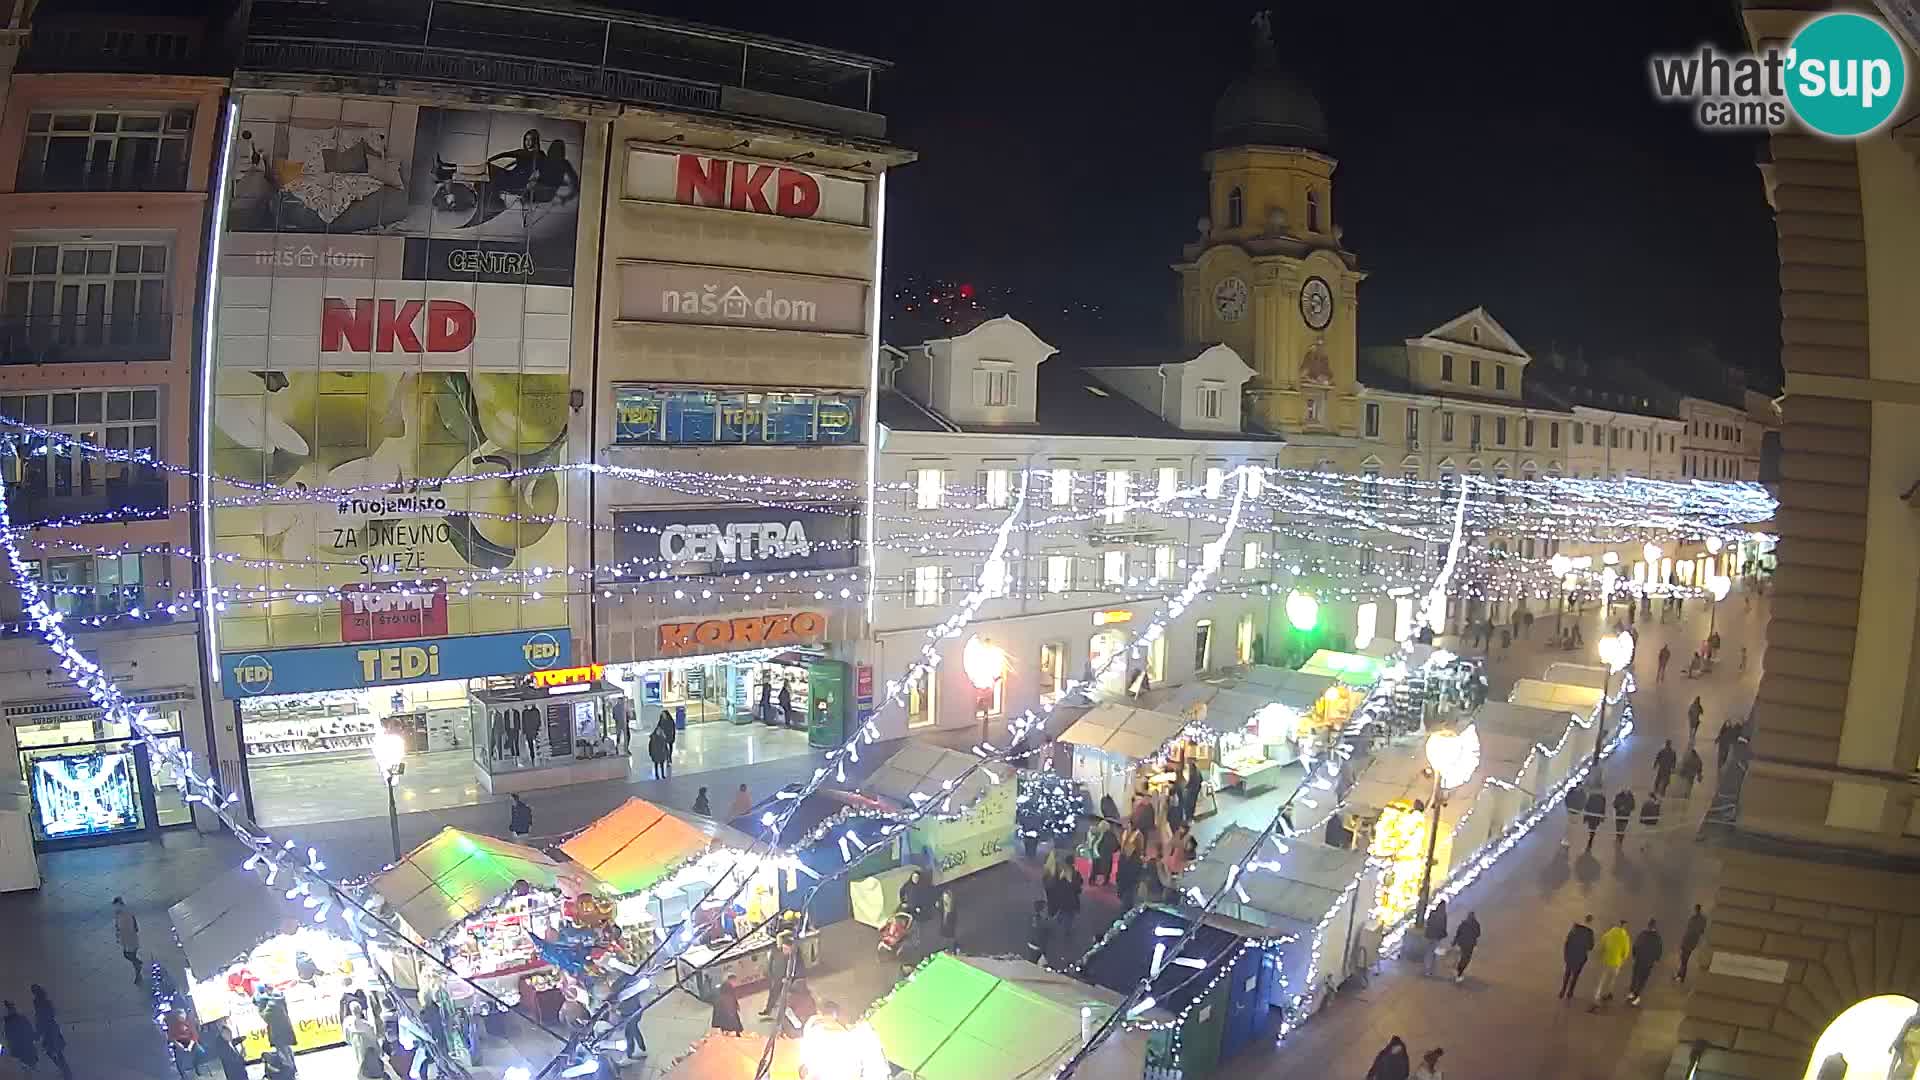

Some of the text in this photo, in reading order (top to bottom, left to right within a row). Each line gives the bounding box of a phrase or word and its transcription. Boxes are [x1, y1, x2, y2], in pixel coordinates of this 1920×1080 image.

[675, 153, 820, 218] NKD
[447, 249, 536, 276] CENTRA
[662, 284, 817, 323] naš dom
[320, 296, 477, 354] NKD
[337, 497, 447, 516] #TvojeMisto
[333, 523, 451, 549] ZA DNEVNO
[659, 520, 811, 563] CENTRA
[659, 612, 826, 652] KORZO
[357, 644, 439, 682] TEDi
[522, 641, 560, 663] TEDi
[234, 665, 273, 684] TEDi
